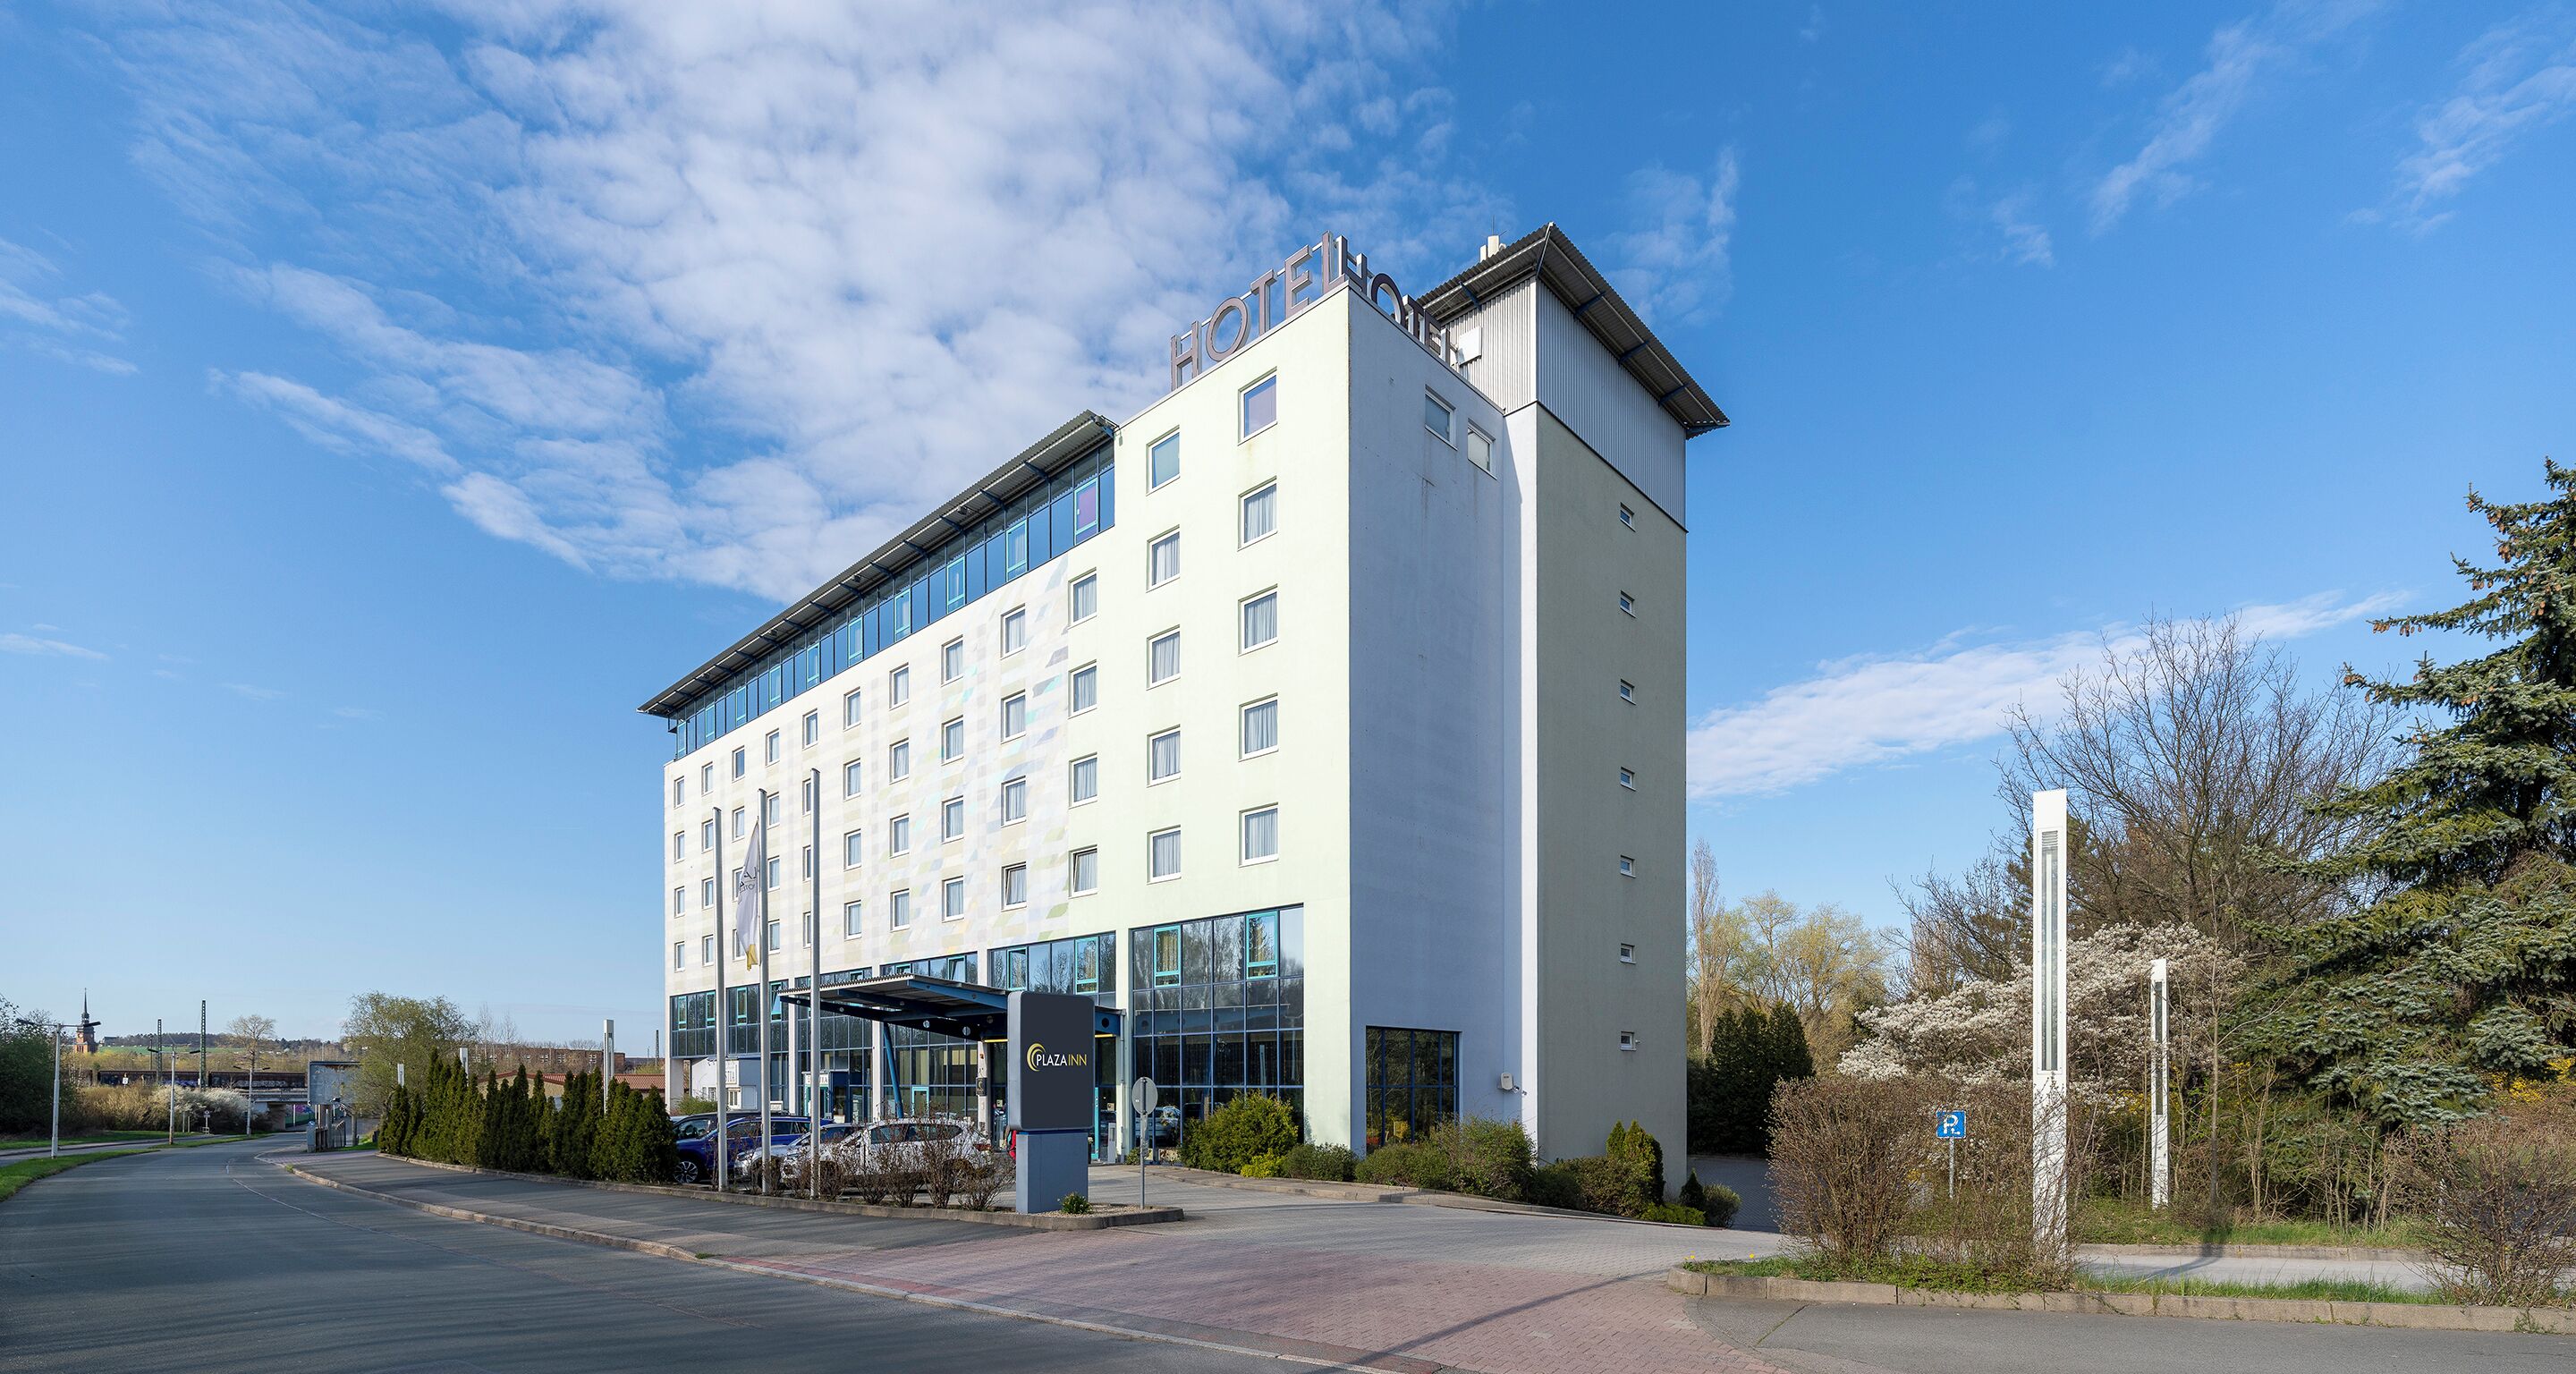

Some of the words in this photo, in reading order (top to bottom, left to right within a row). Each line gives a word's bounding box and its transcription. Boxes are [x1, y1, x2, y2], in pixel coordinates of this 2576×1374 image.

[1171, 230, 1345, 392] HOTEL
[1336, 234, 1450, 366] HOTEL
[1944, 1115, 1959, 1134] P
